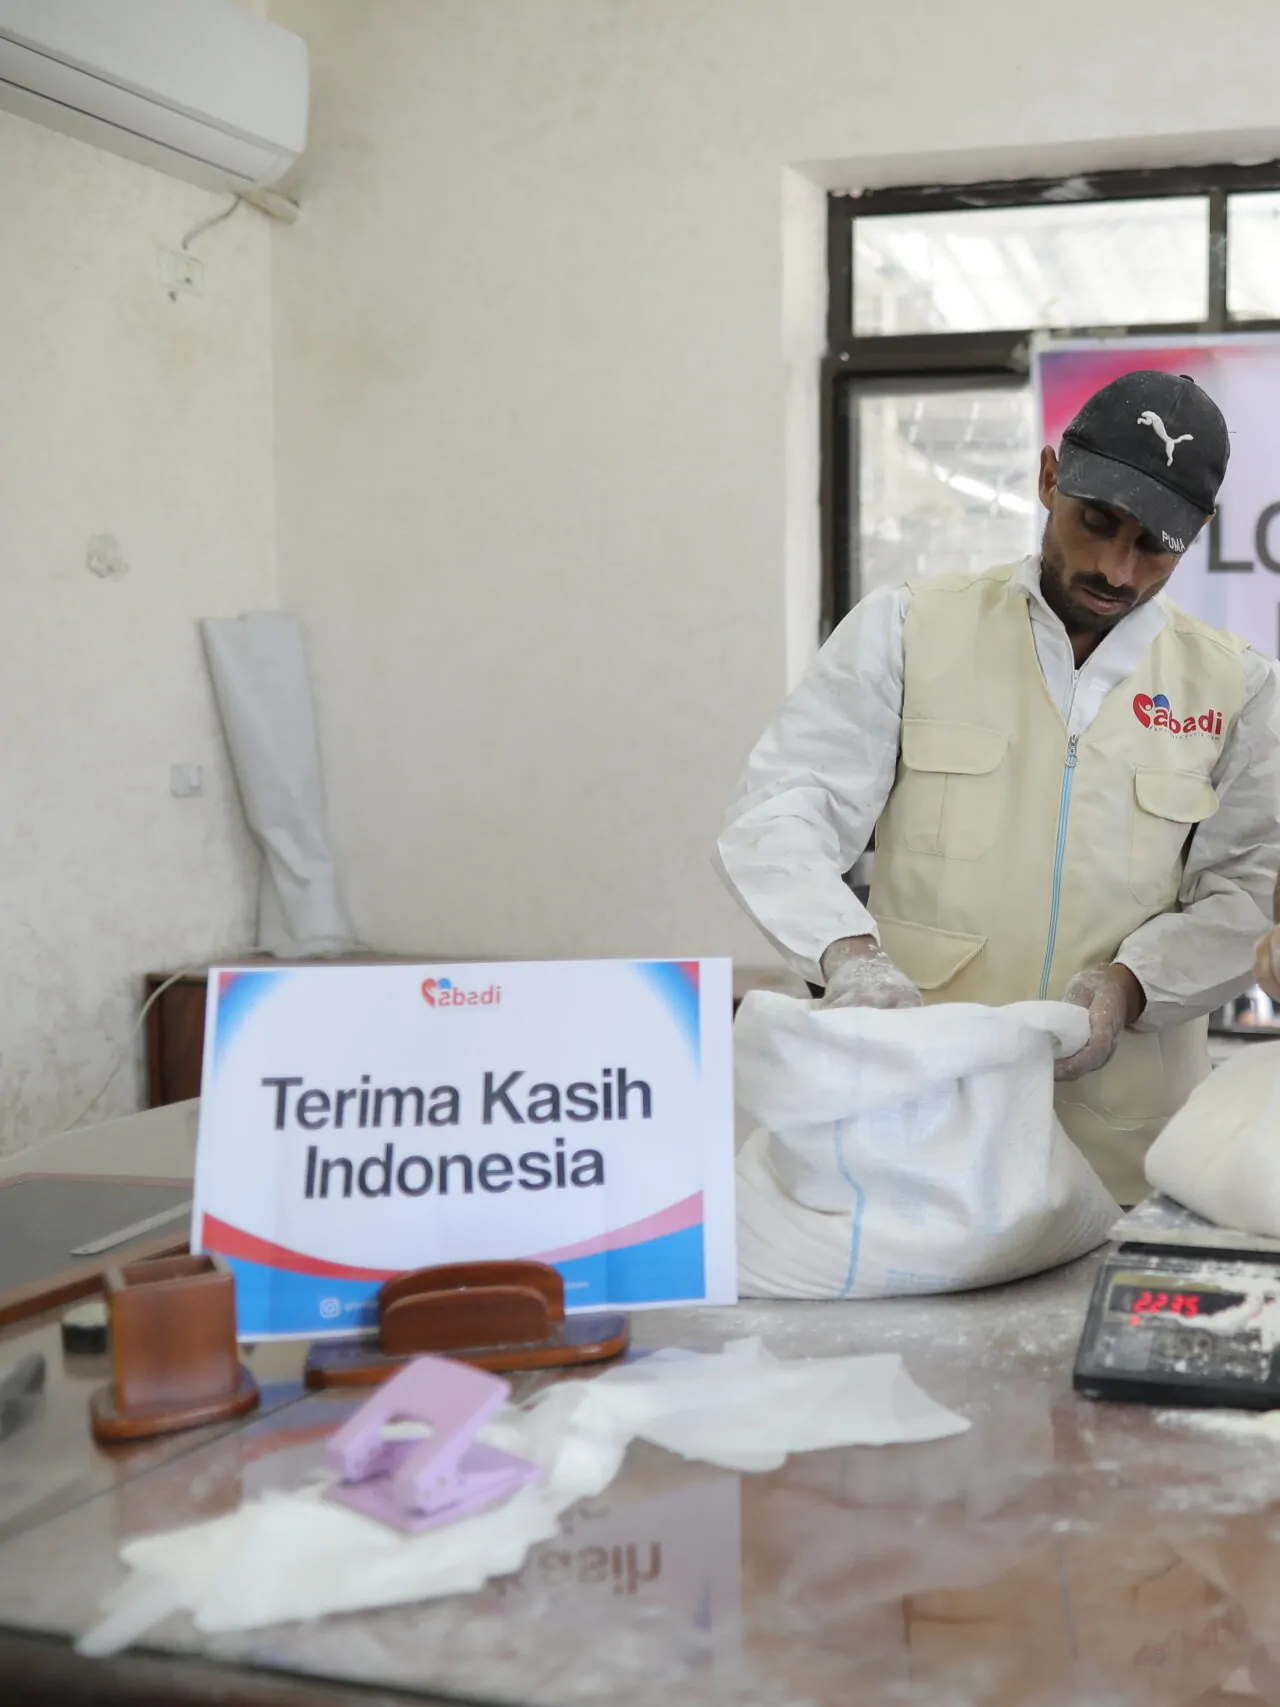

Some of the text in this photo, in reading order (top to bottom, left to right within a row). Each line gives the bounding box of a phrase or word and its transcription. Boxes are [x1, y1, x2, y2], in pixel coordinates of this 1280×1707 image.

[1161, 530, 1186, 552] PUMA
[1153, 708, 1223, 735] abadi
[439, 985, 502, 1006] abadi
[261, 1067, 652, 1131] Terima Kasih
[304, 1138, 605, 1199] Indonesia
